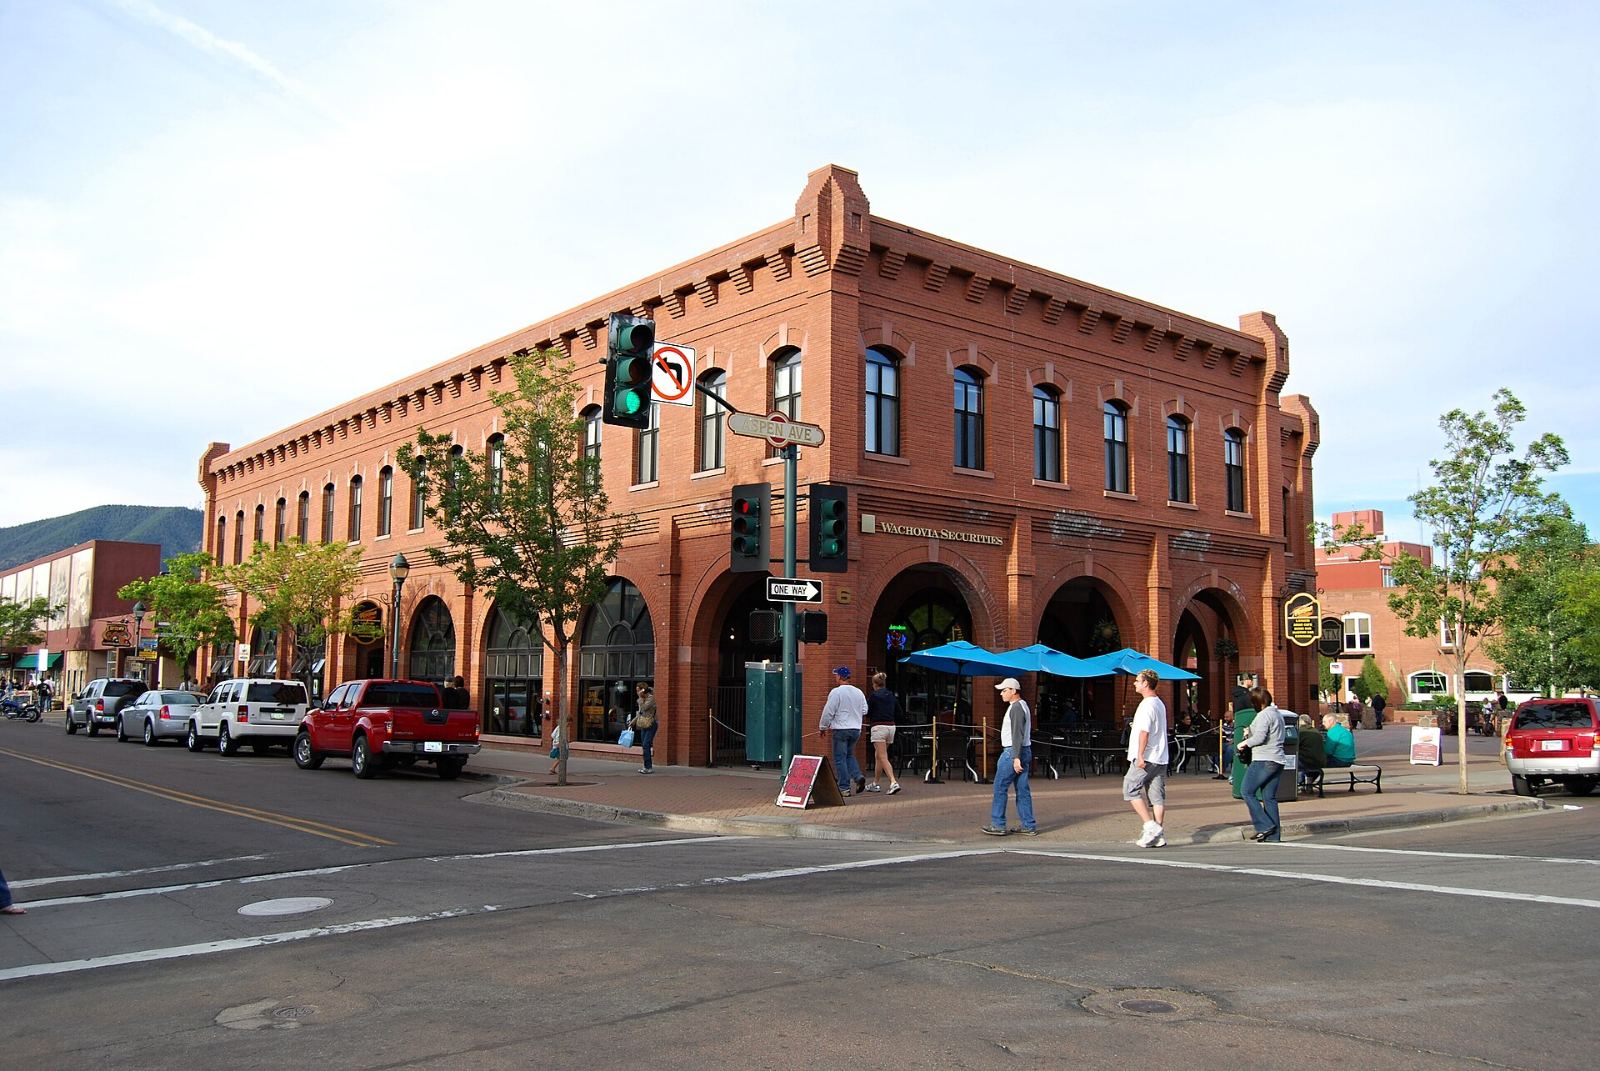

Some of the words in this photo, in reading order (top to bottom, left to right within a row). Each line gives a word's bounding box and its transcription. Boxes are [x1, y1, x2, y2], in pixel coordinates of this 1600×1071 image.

[743, 419, 783, 436] ASPEN
[788, 425, 812, 440] AVE
[880, 521, 939, 539] WACHOVIA
[940, 528, 1004, 546] SECURITIES
[773, 584, 789, 594] ONE
[792, 586, 807, 595] WAY
